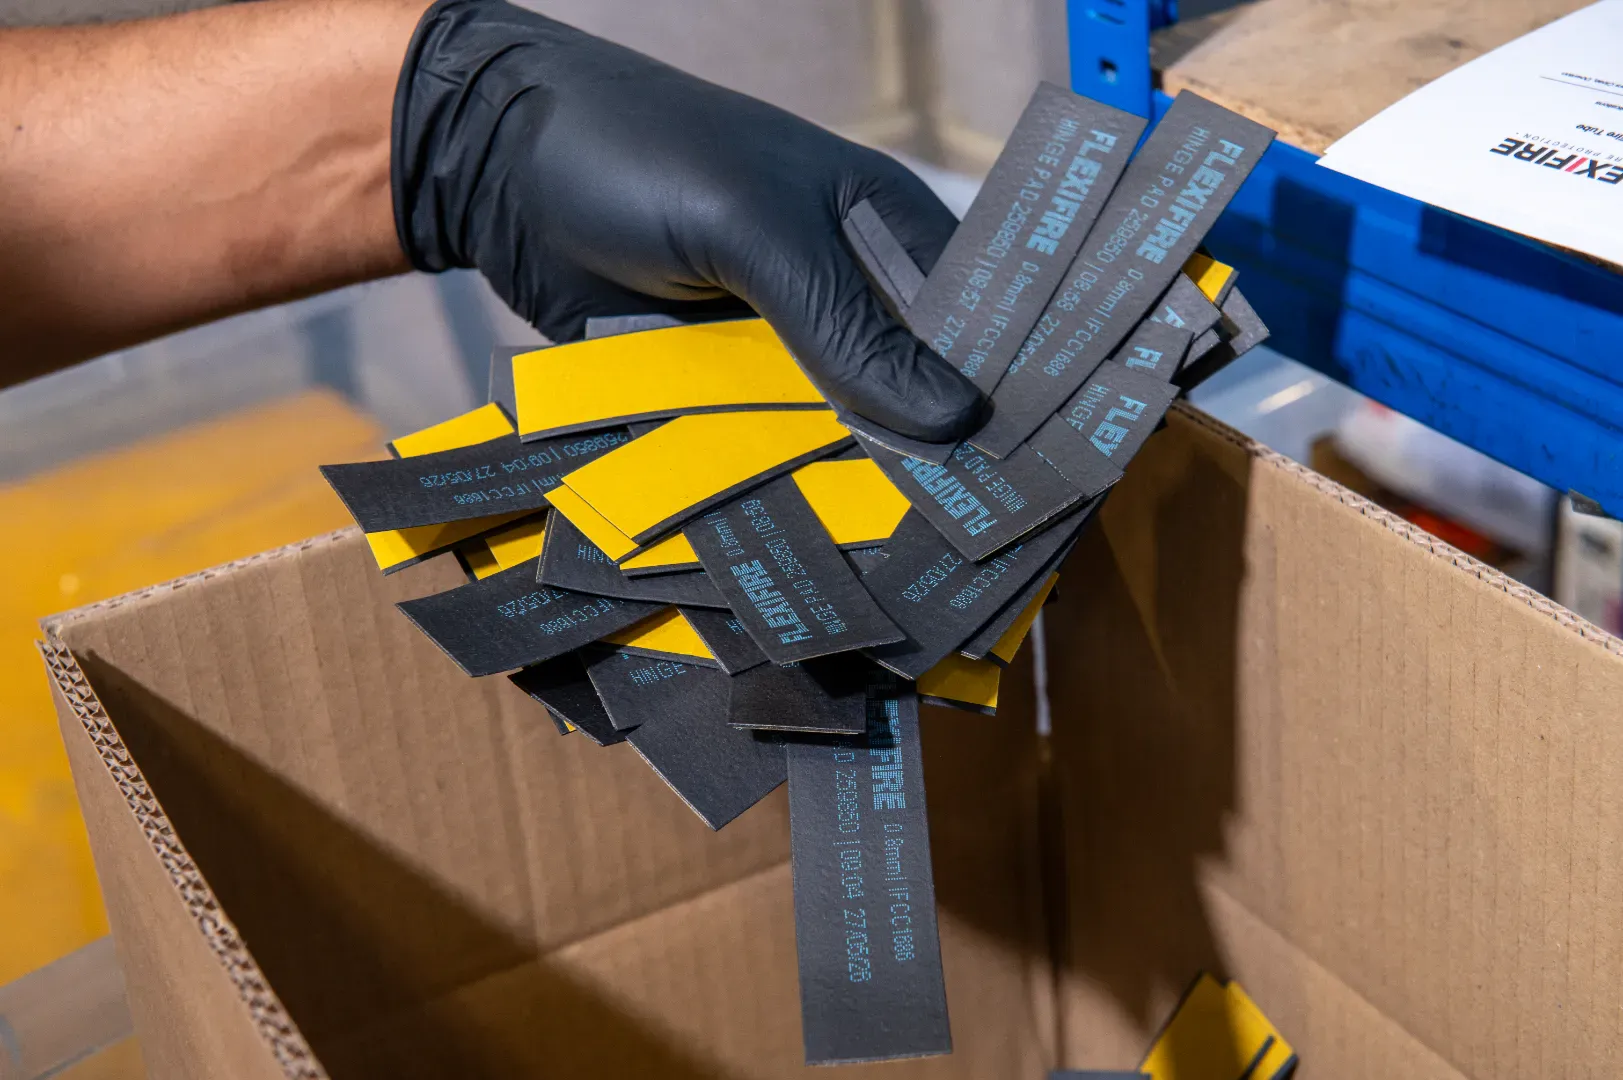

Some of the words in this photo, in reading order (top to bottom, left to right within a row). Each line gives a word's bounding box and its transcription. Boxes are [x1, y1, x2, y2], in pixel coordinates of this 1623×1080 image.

[1037, 118, 1079, 166] HINGE
[1523, 132, 1602, 158] PROTECTION
[1576, 123, 1605, 137] Tube
[1165, 126, 1210, 174] HINGE
[1018, 167, 1052, 201] PAD
[1025, 128, 1119, 257] FLEXIFIRE
[1136, 132, 1246, 265] FLEXIFIRE
[1139, 175, 1175, 208] PAD
[963, 451, 996, 485] PAD
[985, 476, 1027, 512] HINGE
[793, 579, 818, 604] PAD
[902, 552, 963, 603] 27/05/26
[497, 586, 568, 620] 7/05/26
[729, 546, 813, 645] FLEXIFIRE
[809, 603, 846, 635] HINGE
[629, 662, 687, 685] HINGE
[835, 769, 861, 833] 259850
[843, 908, 872, 983] 27/05/26
